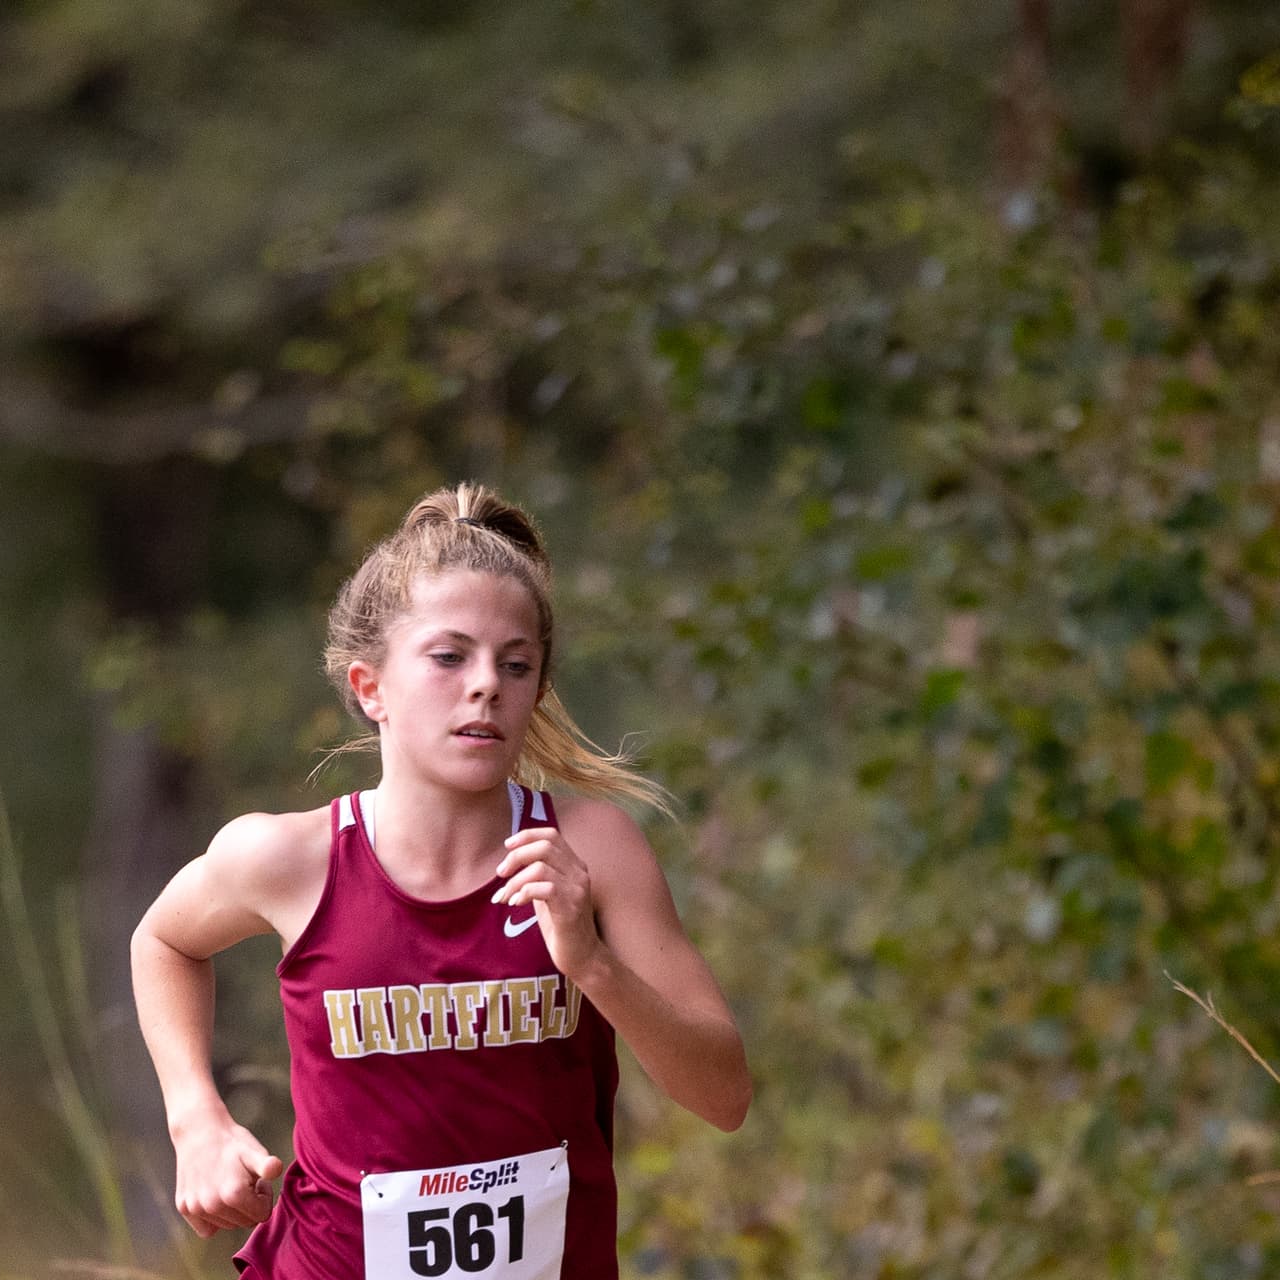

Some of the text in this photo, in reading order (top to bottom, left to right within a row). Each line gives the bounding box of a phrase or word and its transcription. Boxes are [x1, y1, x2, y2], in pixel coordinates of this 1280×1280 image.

[323, 974, 583, 1058] HARTFIELD
[419, 1161, 519, 1196] MileSplit
[407, 1195, 525, 1277] 561
